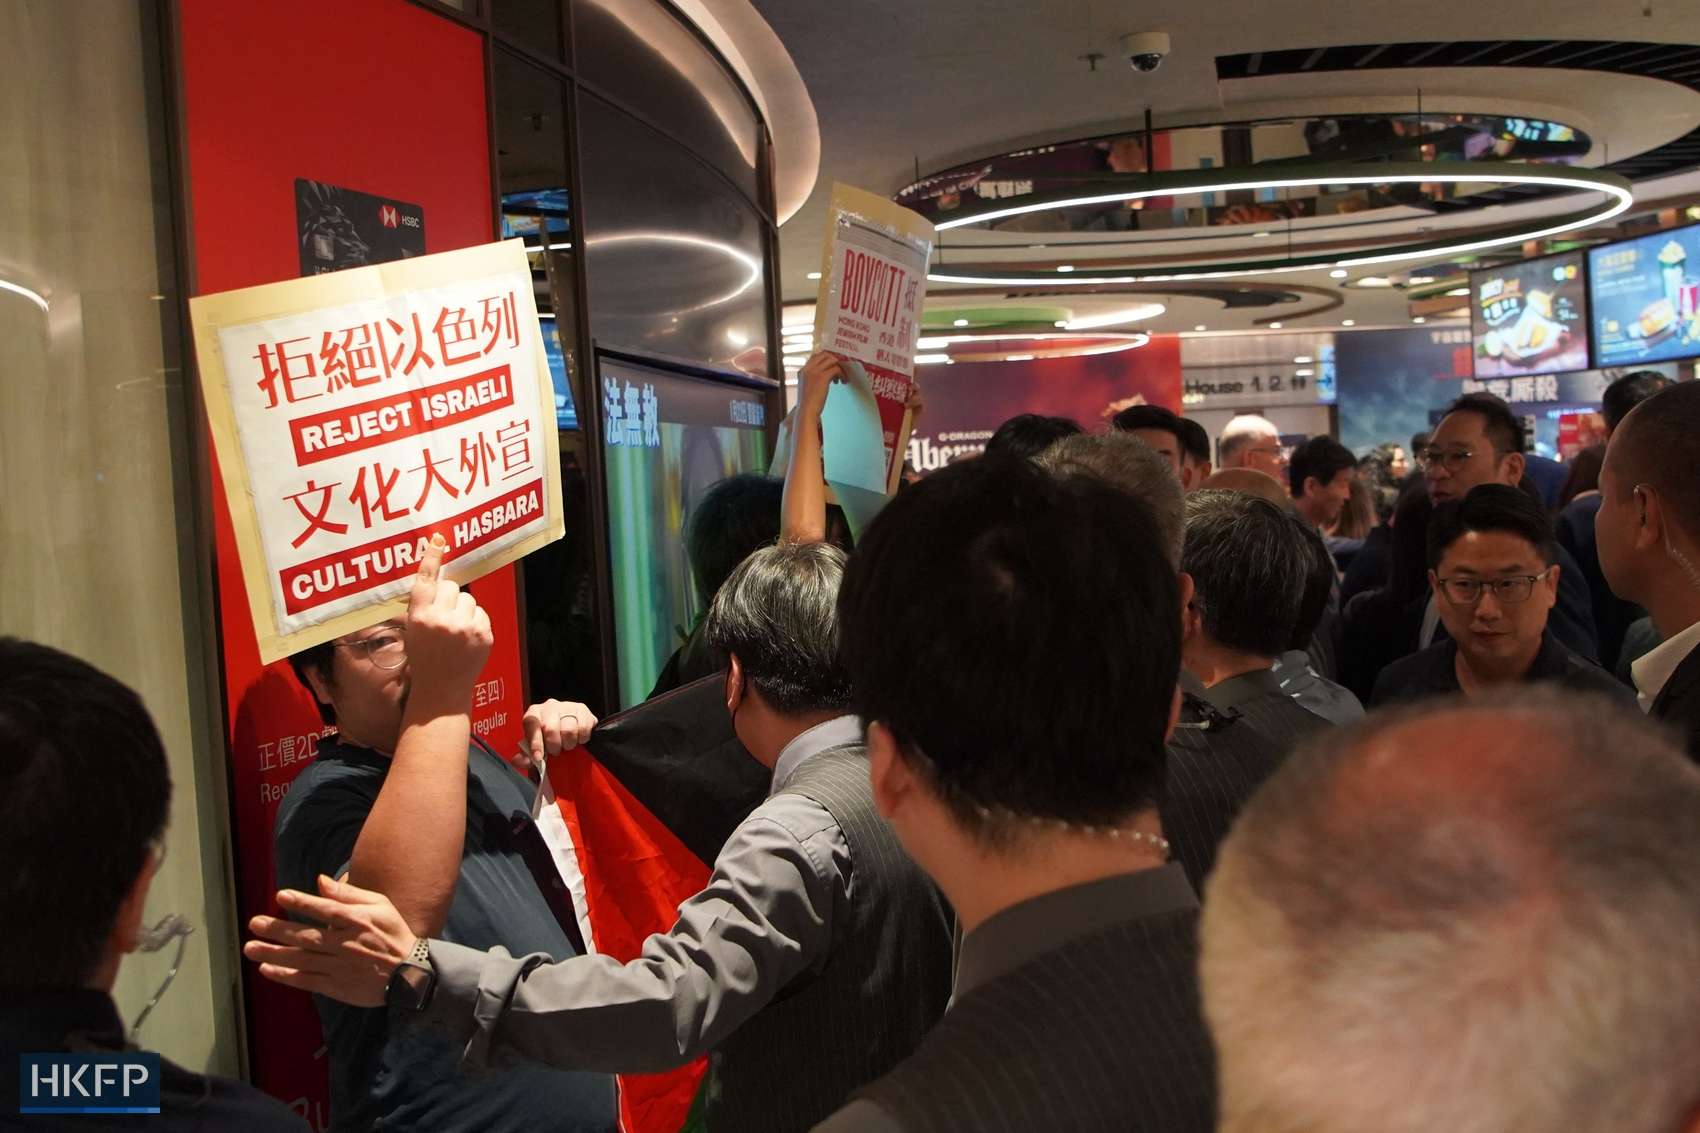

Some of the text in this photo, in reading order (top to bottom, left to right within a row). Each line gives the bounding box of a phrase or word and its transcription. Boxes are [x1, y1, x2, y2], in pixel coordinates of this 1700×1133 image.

[401, 215, 420, 228] HSBC
[840, 249, 905, 327] BOYCOTT
[253, 291, 519, 410] 拒絕以色列
[1184, 375, 1282, 394] House 1 2
[301, 375, 508, 452] REJECT ISRAELI
[938, 430, 994, 442] G-DRAGON
[283, 418, 536, 549] 文化大外宣
[291, 490, 540, 600] CULTURA HASBARA
[473, 711, 507, 735] regular
